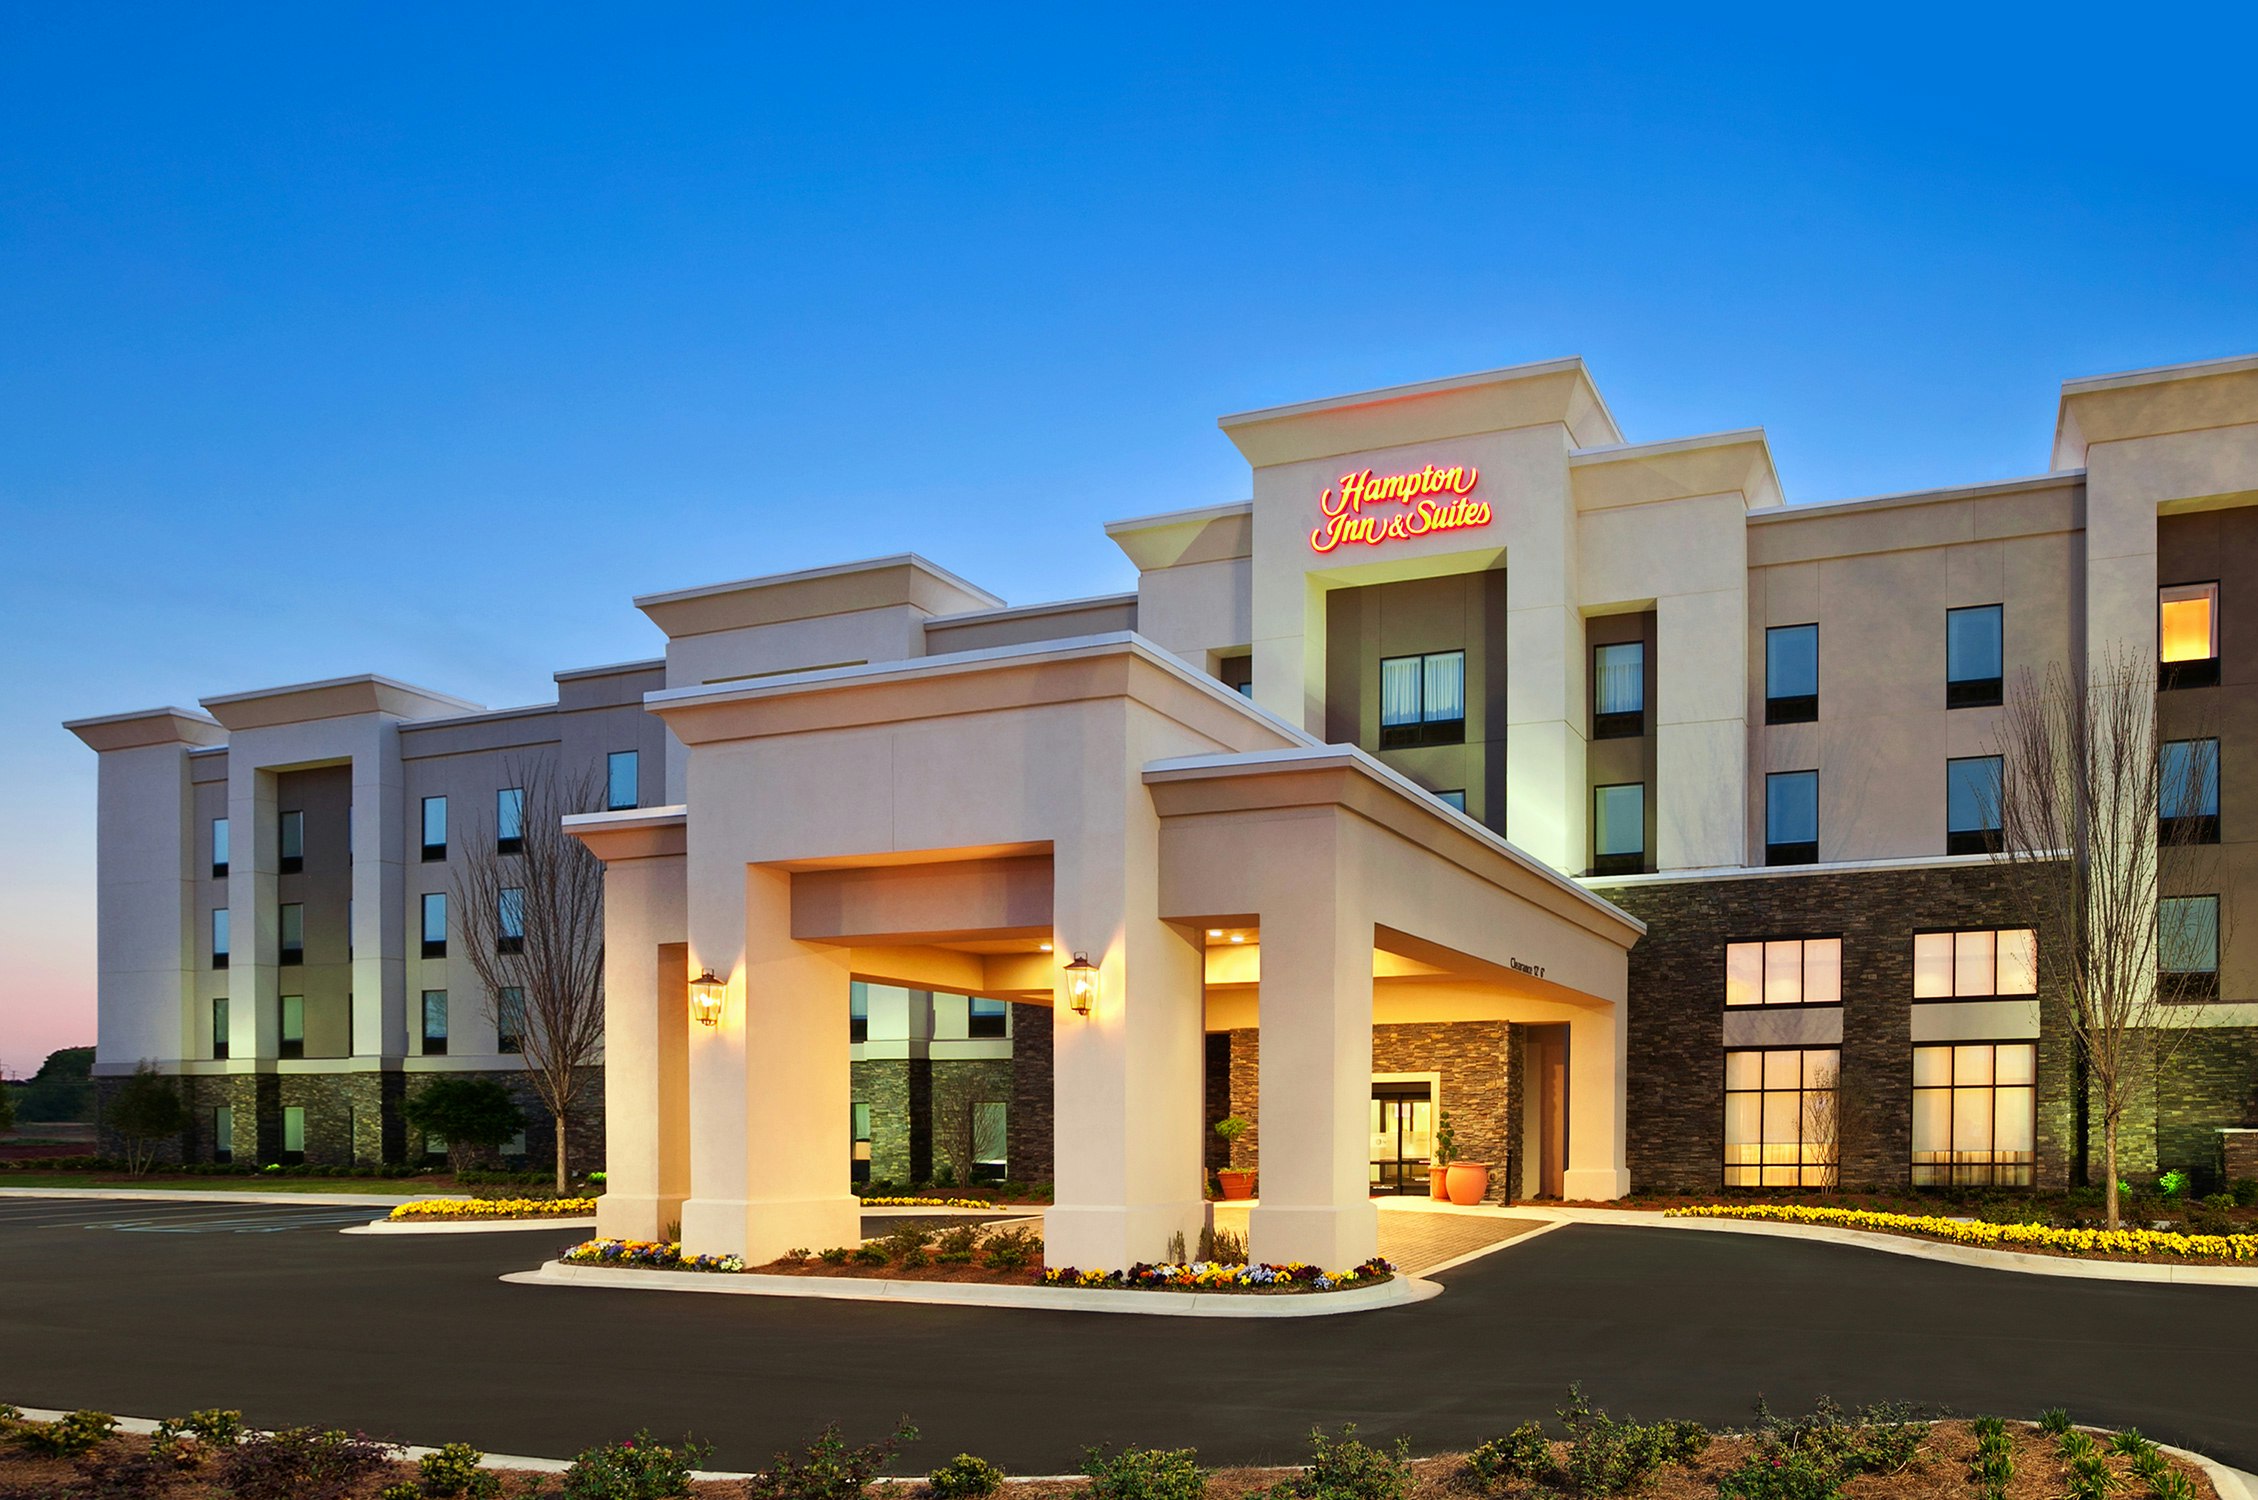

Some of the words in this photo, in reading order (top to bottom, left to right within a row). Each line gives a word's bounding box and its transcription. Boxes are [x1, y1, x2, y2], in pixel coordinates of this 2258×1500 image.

[1321, 464, 1479, 517] Hampton
[1310, 512, 1388, 553] Inn
[1387, 514, 1410, 540] &
[1406, 497, 1492, 535] Suites
